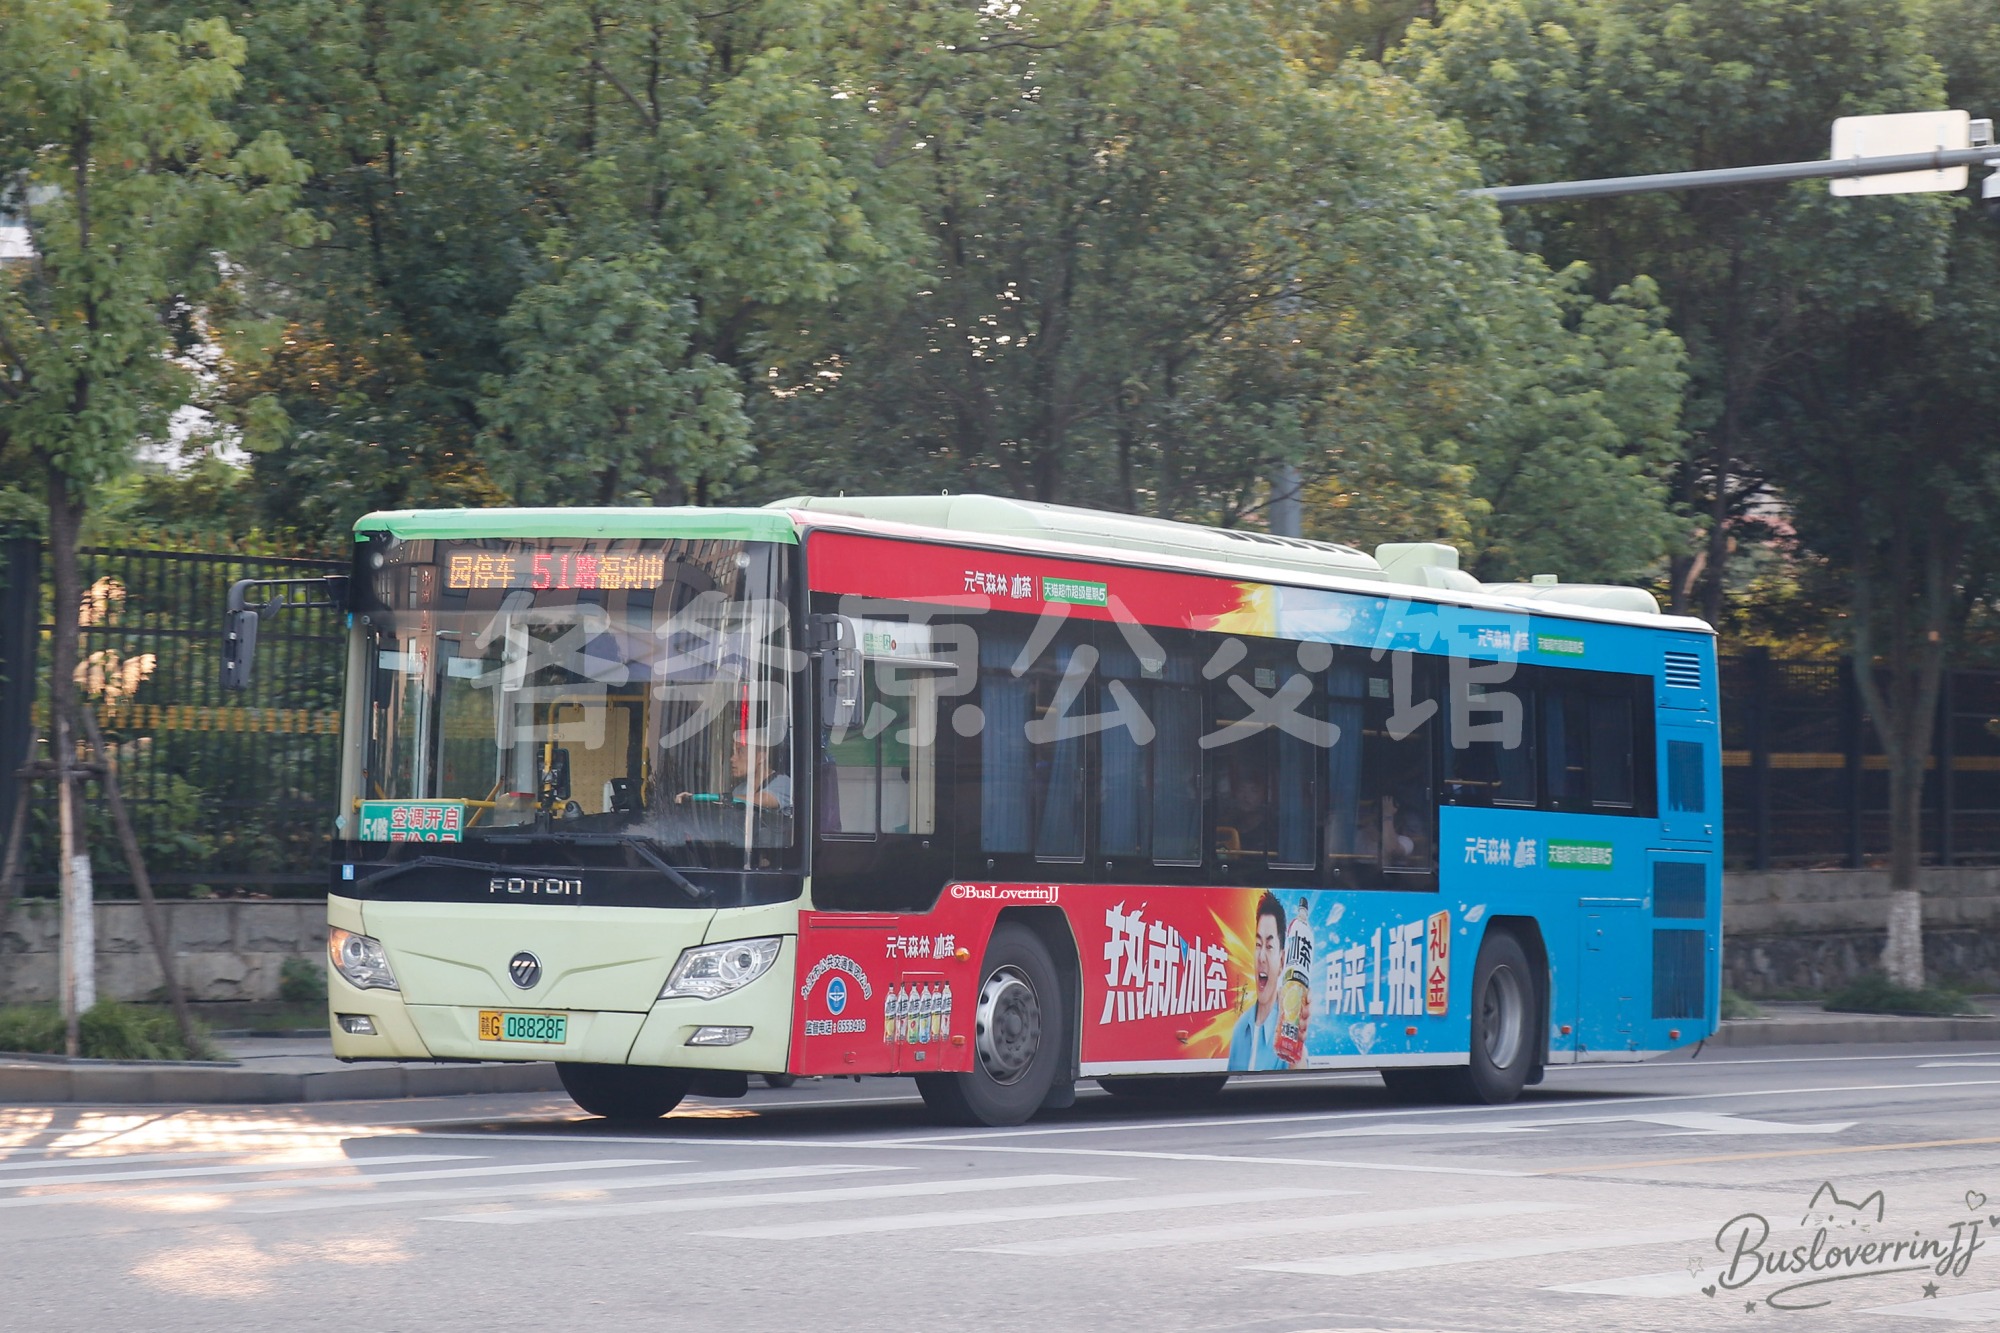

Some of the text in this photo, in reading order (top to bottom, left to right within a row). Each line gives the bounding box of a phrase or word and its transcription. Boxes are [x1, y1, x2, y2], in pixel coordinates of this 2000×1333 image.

[964, 570, 1008, 596] 元气森林
[1010, 573, 1032, 599] 冰茶
[391, 806, 460, 830] 空调开启
[1465, 837, 1511, 866] 元气森林
[489, 878, 582, 895] FOTON
[886, 933, 955, 960] 元气森林 冰茶
[1099, 900, 1229, 1025] 热就冰茶
[1325, 919, 1425, 1016] 再来1瓶
[1427, 918, 1447, 1008] 礼金
